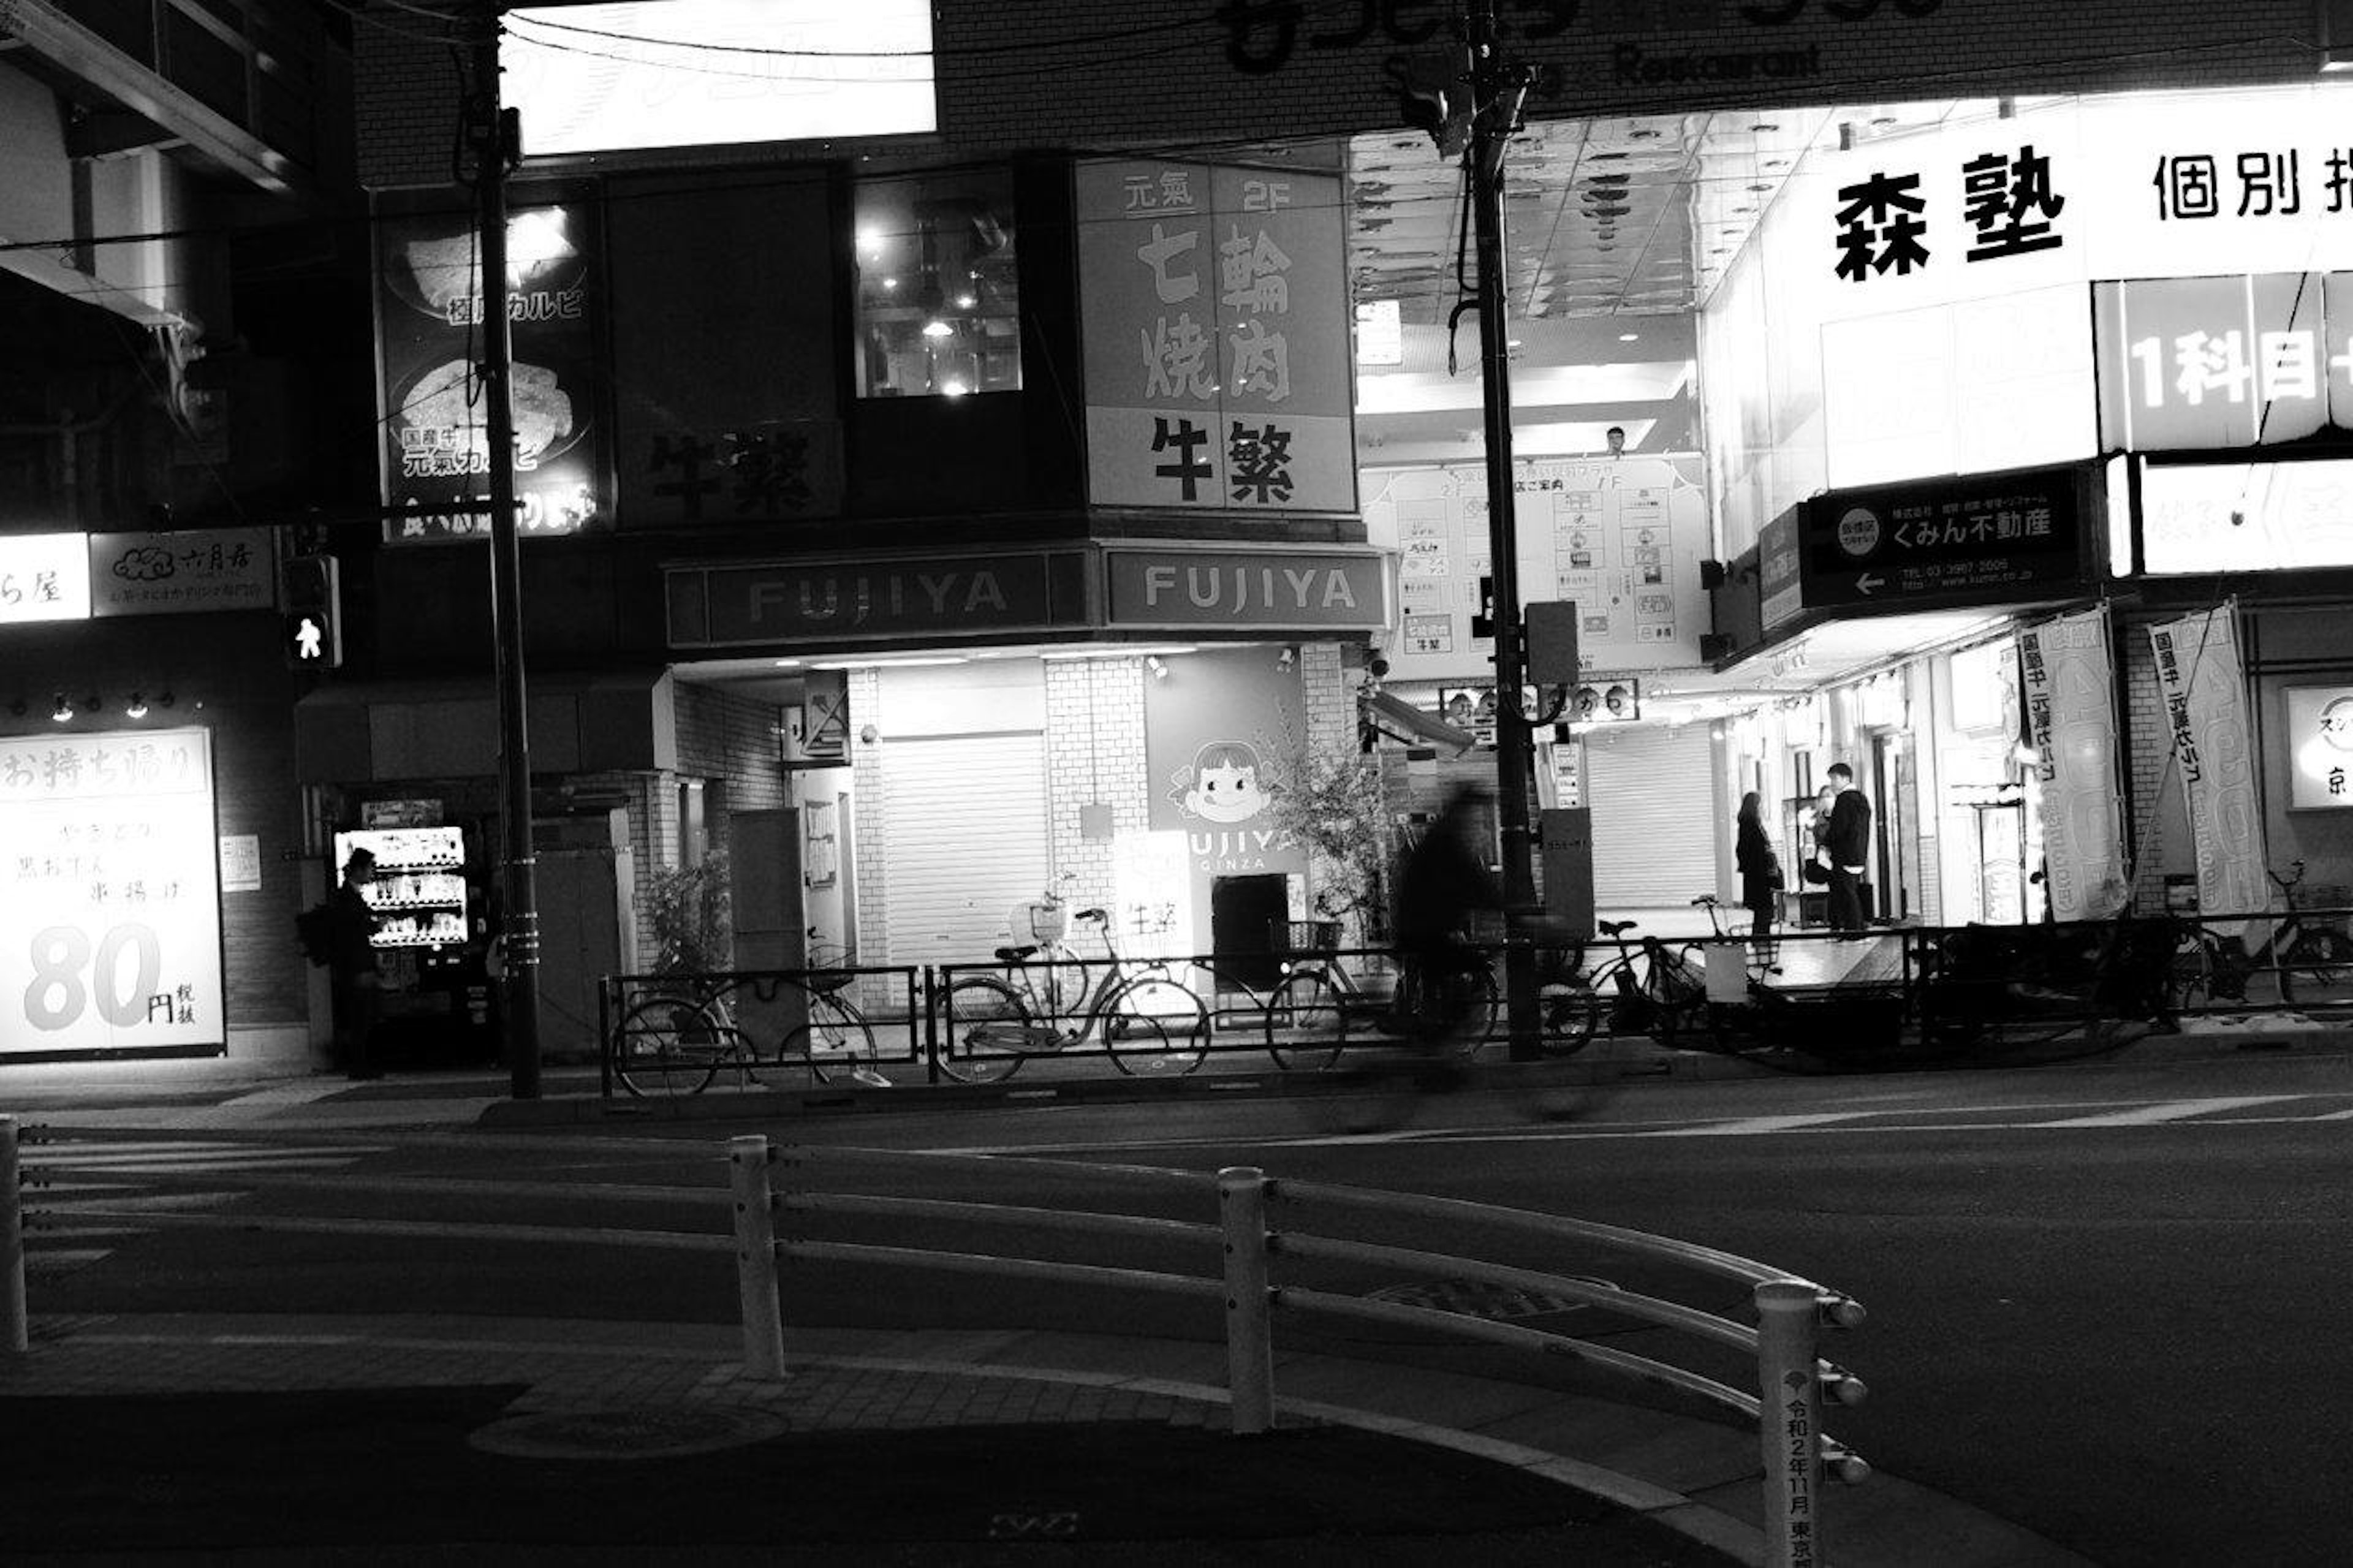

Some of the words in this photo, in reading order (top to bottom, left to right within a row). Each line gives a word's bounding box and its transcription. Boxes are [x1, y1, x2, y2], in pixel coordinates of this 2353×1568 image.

[1243, 181, 1290, 213] 2F
[1835, 145, 2066, 282] 森塾
[1136, 223, 1293, 314] 七輪
[1151, 417, 1294, 504] 牛繁
[1894, 508, 2052, 547] くみん不動産
[749, 570, 1008, 626] FUJIYA
[1144, 565, 1357, 613] FUJIYA
[1785, 1398, 1809, 1515] 令和2年11月
